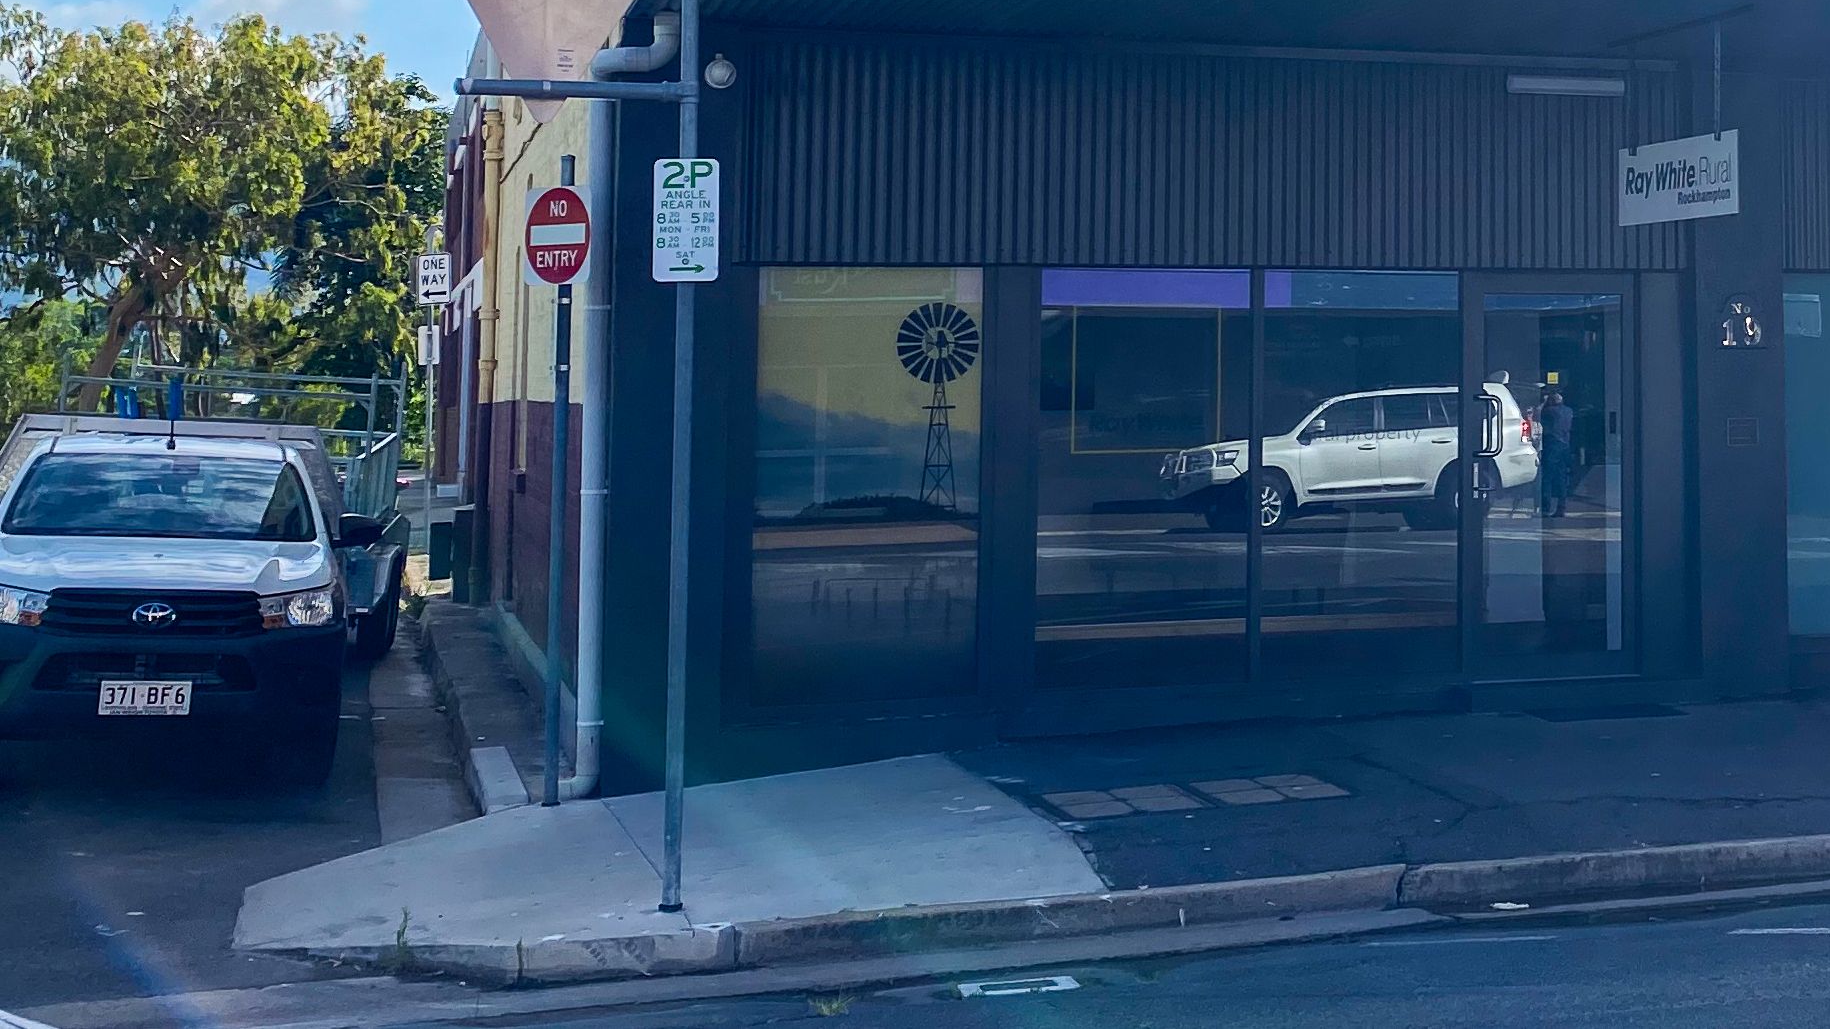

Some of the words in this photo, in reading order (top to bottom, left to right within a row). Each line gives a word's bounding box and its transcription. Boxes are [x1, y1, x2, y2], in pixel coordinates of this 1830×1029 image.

[662, 161, 714, 189] 2P
[1698, 152, 1732, 186] Rural
[665, 190, 707, 200] ANGLE
[1677, 187, 1731, 206] Rockhampton
[549, 200, 568, 218] NO
[660, 200, 693, 210] REAR
[699, 200, 711, 209] IN
[659, 226, 682, 234] MON
[694, 226, 711, 234] FRI
[536, 249, 579, 269] ENTRY
[675, 251, 695, 259] SAT
[422, 258, 446, 271] ONE
[421, 273, 447, 286] WAY
[1721, 316, 1762, 346] 19
[104, 686, 136, 705] 371
[146, 685, 186, 705] BF6
